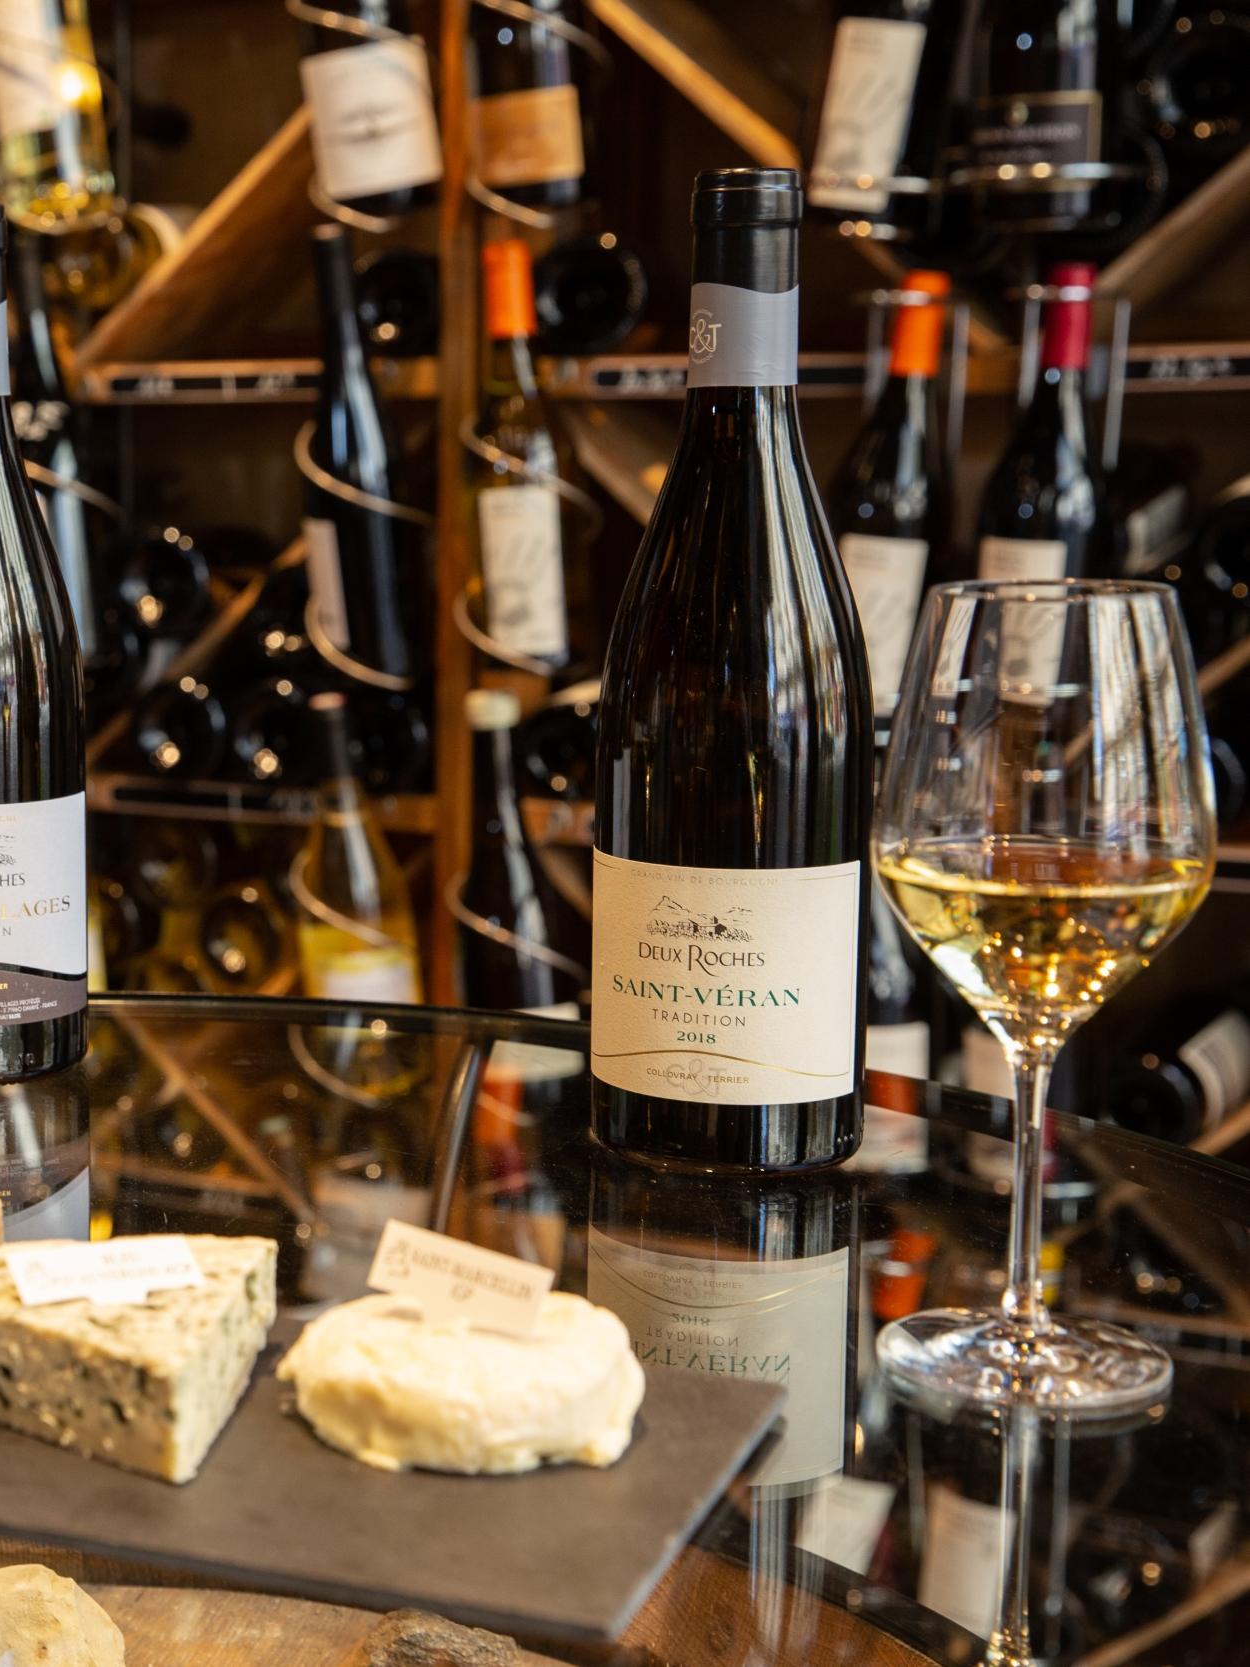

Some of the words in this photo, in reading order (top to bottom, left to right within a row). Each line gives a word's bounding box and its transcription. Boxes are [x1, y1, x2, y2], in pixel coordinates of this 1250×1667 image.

[638, 941, 682, 964] DEUX
[688, 944, 765, 977] ROCHES
[612, 974, 800, 1007] SAINT-VÉRAN
[652, 1008, 746, 1027] TRADITION
[676, 1030, 717, 1044] 2018
[646, 1067, 697, 1080] COLLOVRAY
[708, 1075, 750, 1084] TERRIER
